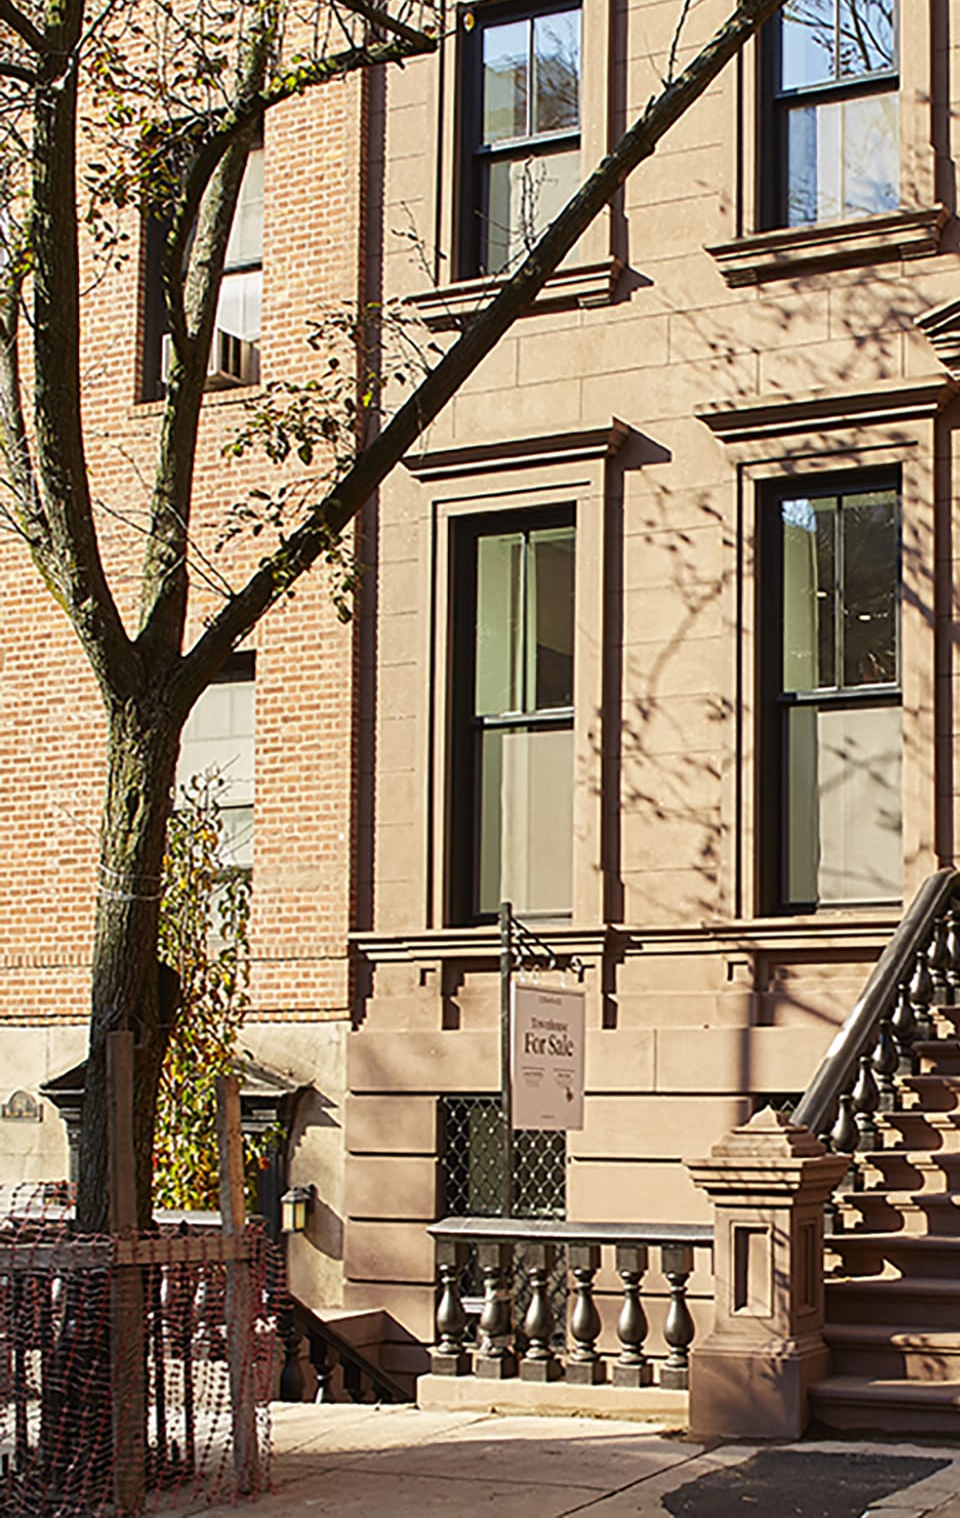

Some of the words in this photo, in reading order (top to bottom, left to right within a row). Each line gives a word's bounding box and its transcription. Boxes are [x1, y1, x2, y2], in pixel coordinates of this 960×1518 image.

[530, 1017, 569, 1032] Townhouse
[524, 1032, 547, 1055] For
[548, 1034, 574, 1057] Sale
